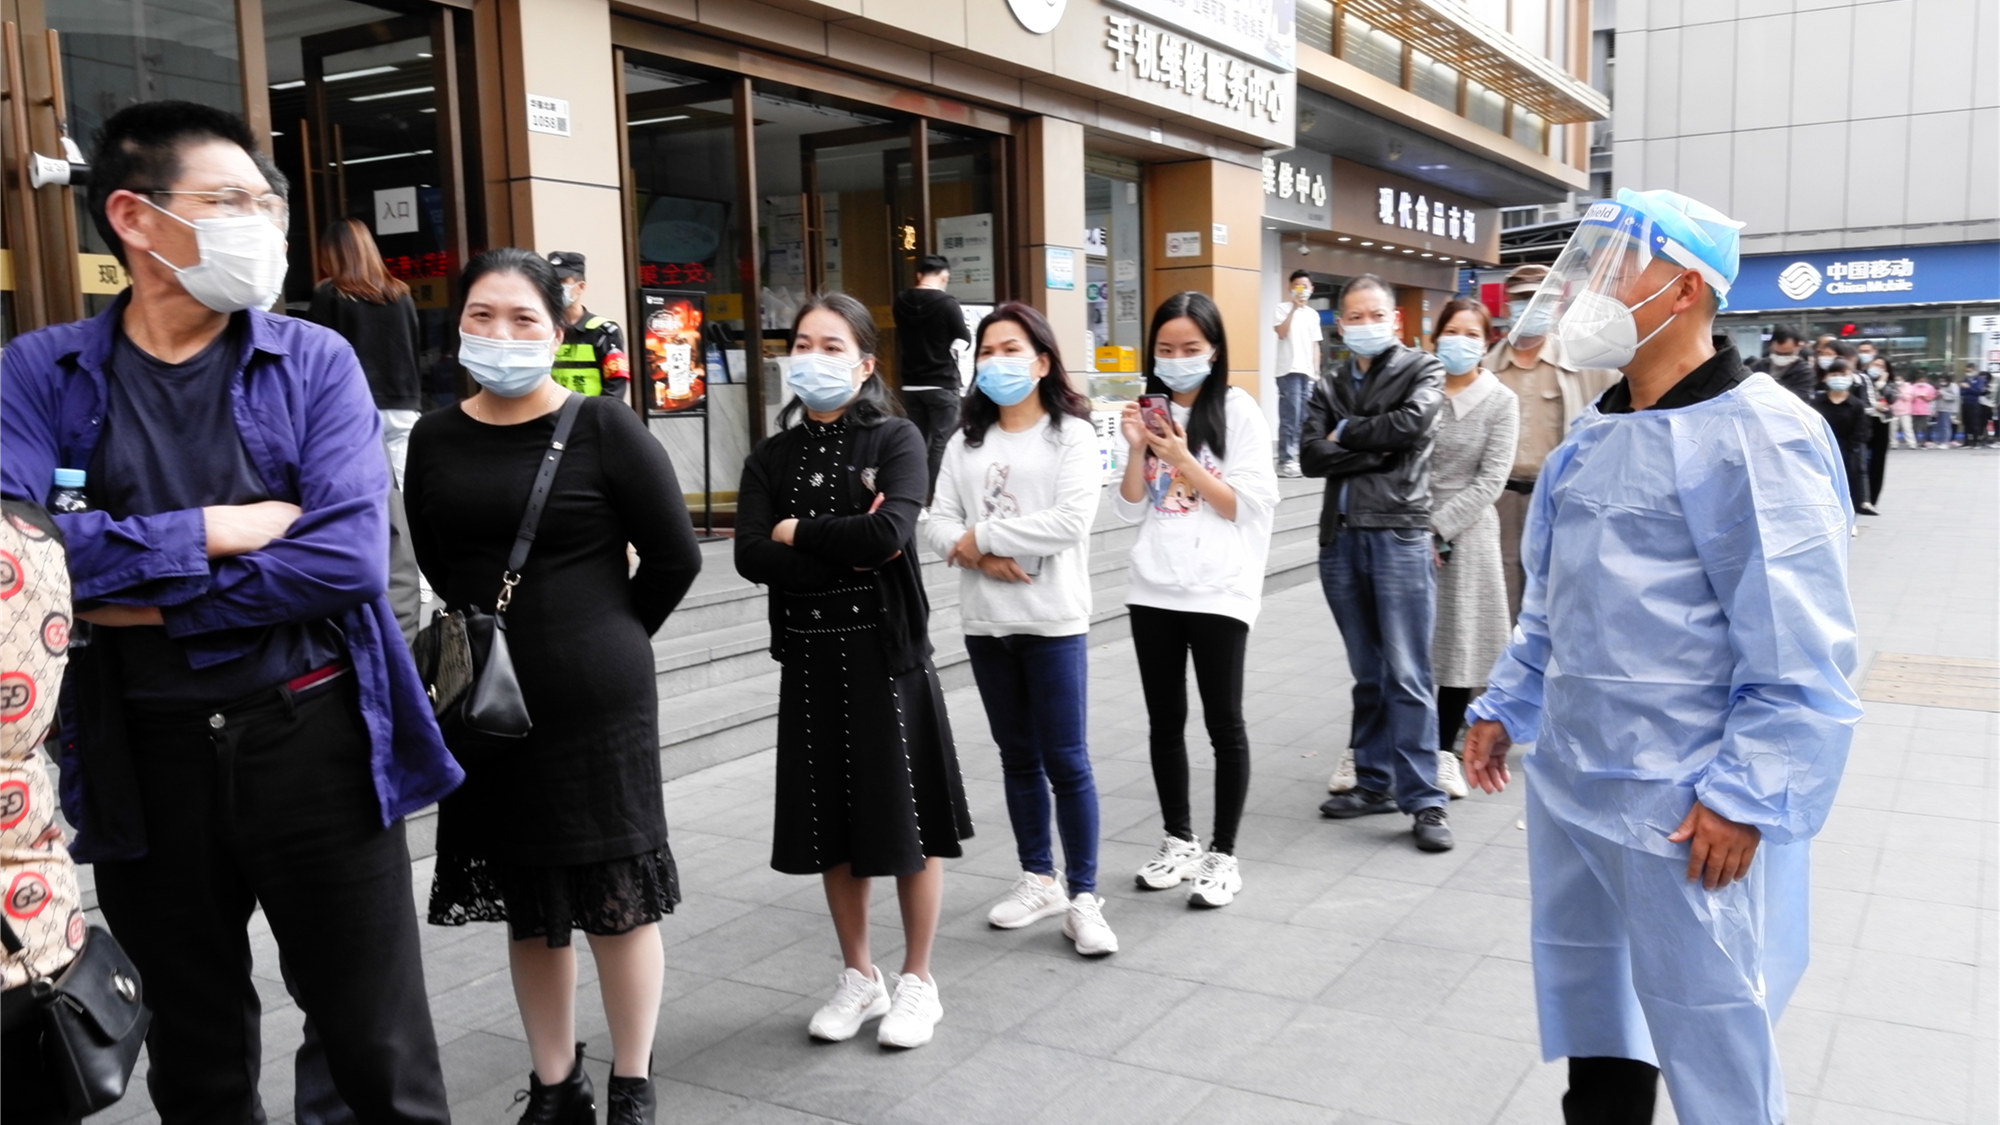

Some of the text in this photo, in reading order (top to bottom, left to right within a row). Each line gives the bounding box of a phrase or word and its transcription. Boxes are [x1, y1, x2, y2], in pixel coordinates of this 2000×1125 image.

[1107, 15, 1282, 122] 手机维修服务中心
[532, 114, 556, 129] 1058
[382, 201, 410, 219] 入口
[1378, 187, 1476, 244] 现代食品市场
[1826, 258, 1915, 281] 中国移动
[1826, 279, 1914, 295] China Mobile
